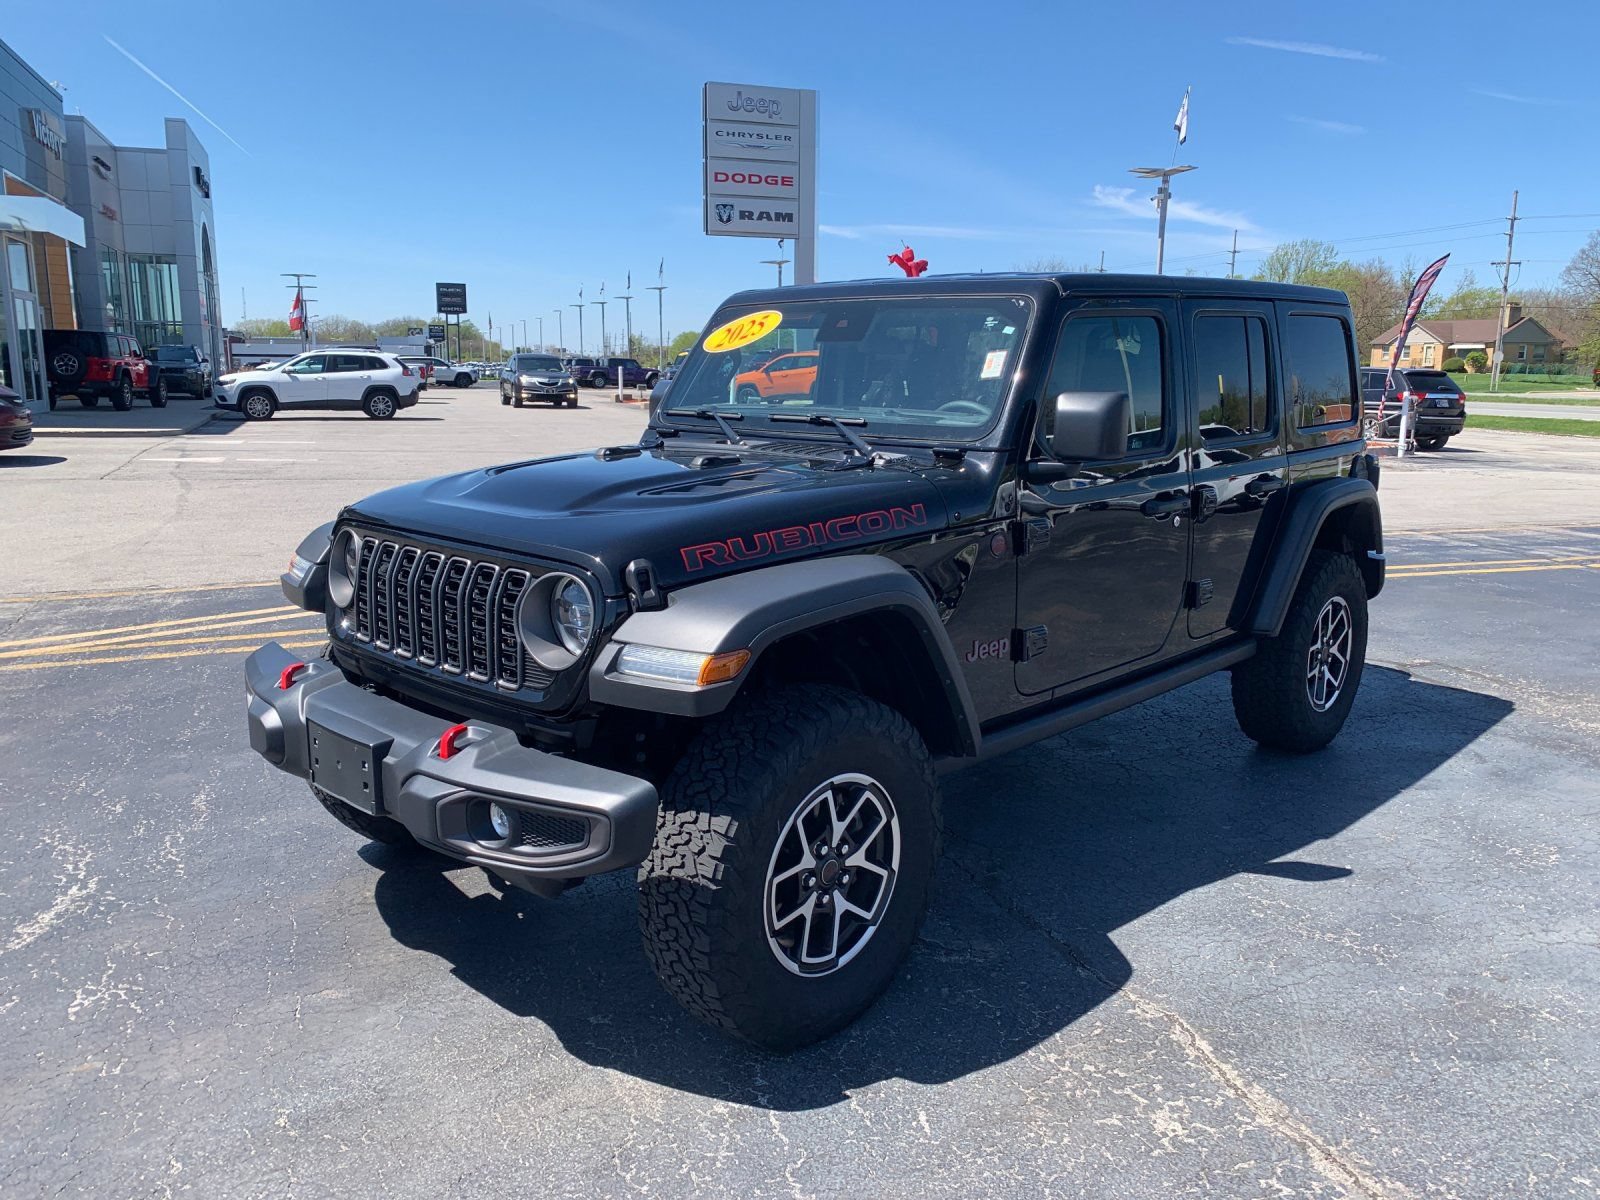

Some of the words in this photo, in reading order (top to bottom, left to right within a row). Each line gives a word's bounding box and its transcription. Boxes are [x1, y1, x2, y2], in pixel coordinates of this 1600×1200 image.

[727, 90, 783, 119] Jeep
[715, 130, 792, 142] CHRYSLER
[714, 171, 794, 187] DODGE
[738, 209, 794, 223] RAM
[714, 314, 770, 348] 2025
[680, 503, 928, 572] RUBICON
[965, 637, 1009, 664] Jeep
